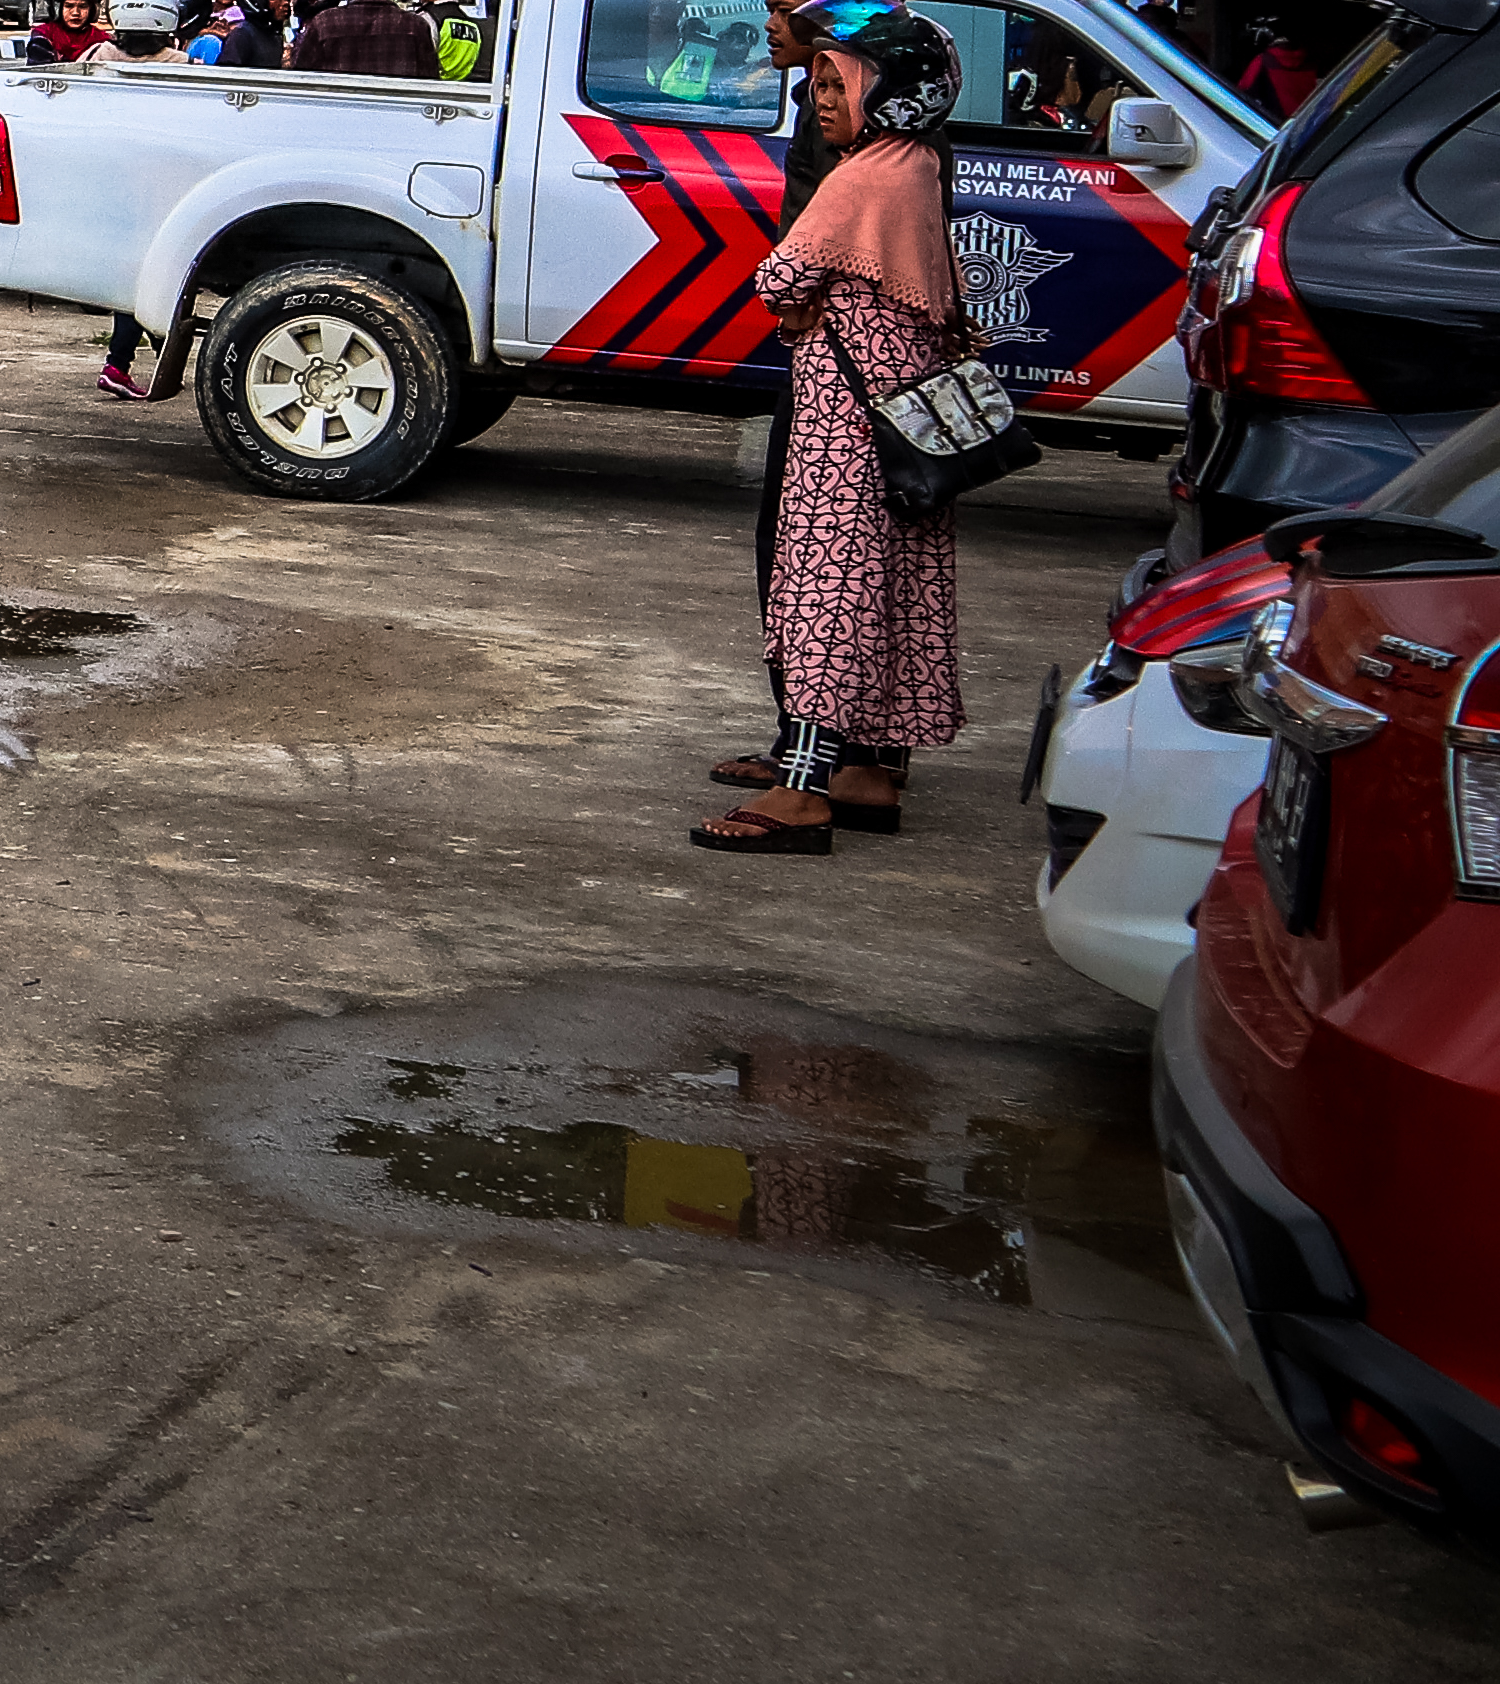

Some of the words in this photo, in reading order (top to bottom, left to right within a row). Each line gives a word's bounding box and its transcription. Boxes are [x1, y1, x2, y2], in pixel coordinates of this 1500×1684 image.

[957, 160, 1002, 178] DAN
[1007, 163, 1116, 186] MELAYANI
[1016, 365, 1092, 387] LINTAS
